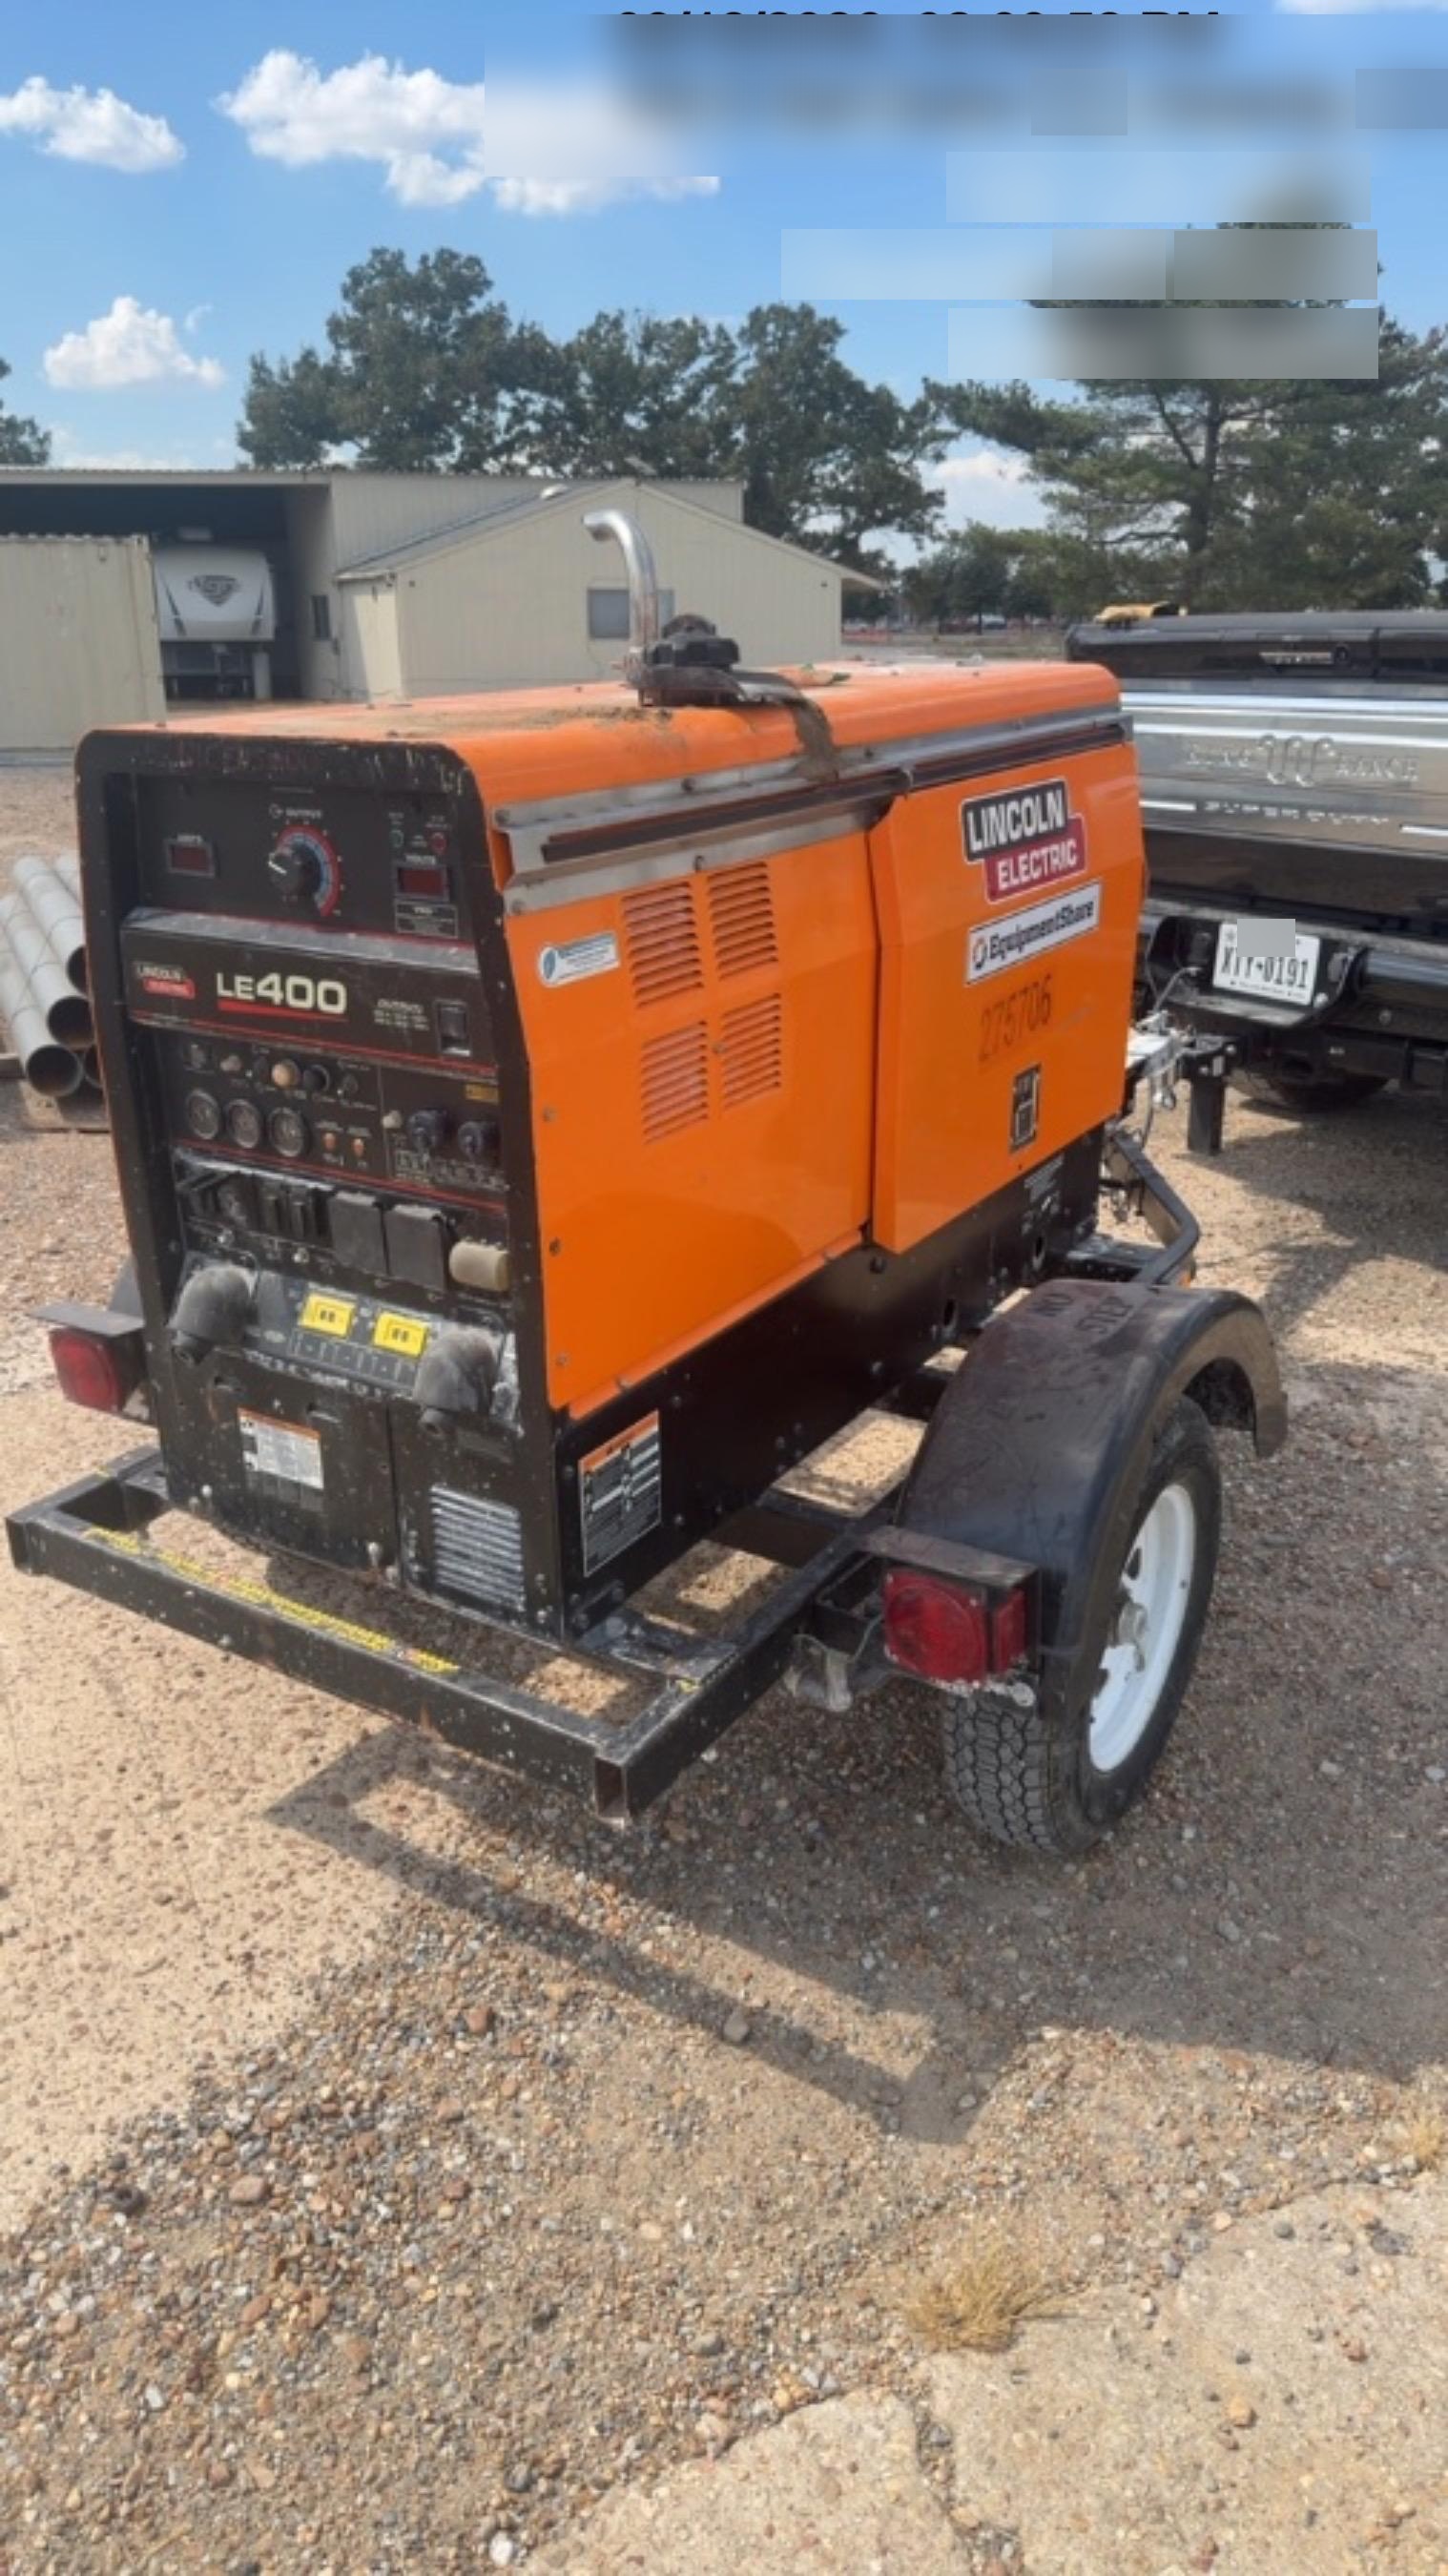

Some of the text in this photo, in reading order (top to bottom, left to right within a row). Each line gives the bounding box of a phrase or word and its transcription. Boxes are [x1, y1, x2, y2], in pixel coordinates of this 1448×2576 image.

[966, 788, 1065, 854] LINCOLN
[997, 839, 1078, 891] ELECTRIC
[989, 901, 1094, 960] EquipmentShare
[216, 971, 347, 1015] LE400
[979, 972, 1051, 1063] 275706
